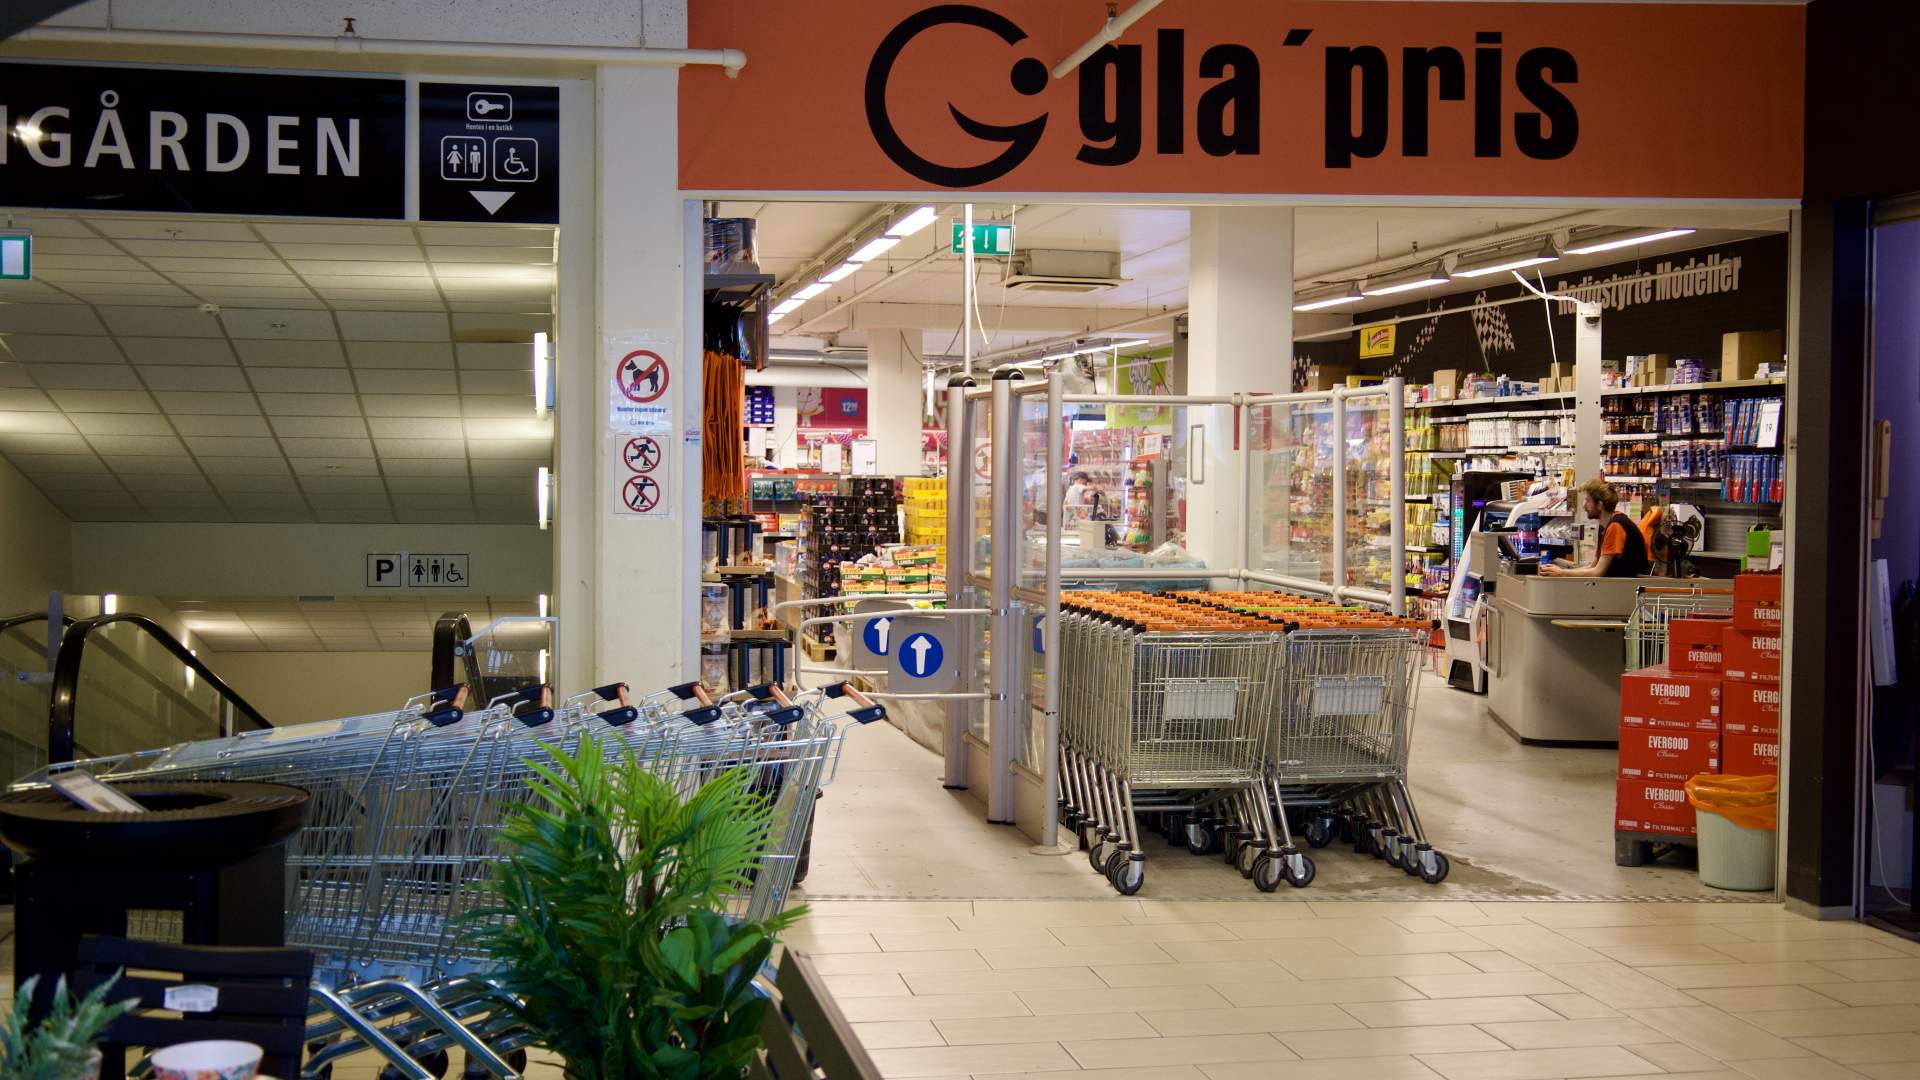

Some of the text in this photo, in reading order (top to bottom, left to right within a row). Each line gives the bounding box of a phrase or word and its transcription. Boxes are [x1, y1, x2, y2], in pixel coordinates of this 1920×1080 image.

[1655, 253, 1742, 302] Modeller
[376, 559, 394, 582] P
[1688, 650, 1722, 663] EVERGOOD
[1650, 683, 1690, 698] EVERGOOD
[1648, 735, 1689, 750] EVERGOOD
[1655, 771, 1689, 780] FILTERMALT
[1644, 787, 1685, 803] EVERGOOD
[1652, 824, 1685, 833] FILTERMALT
